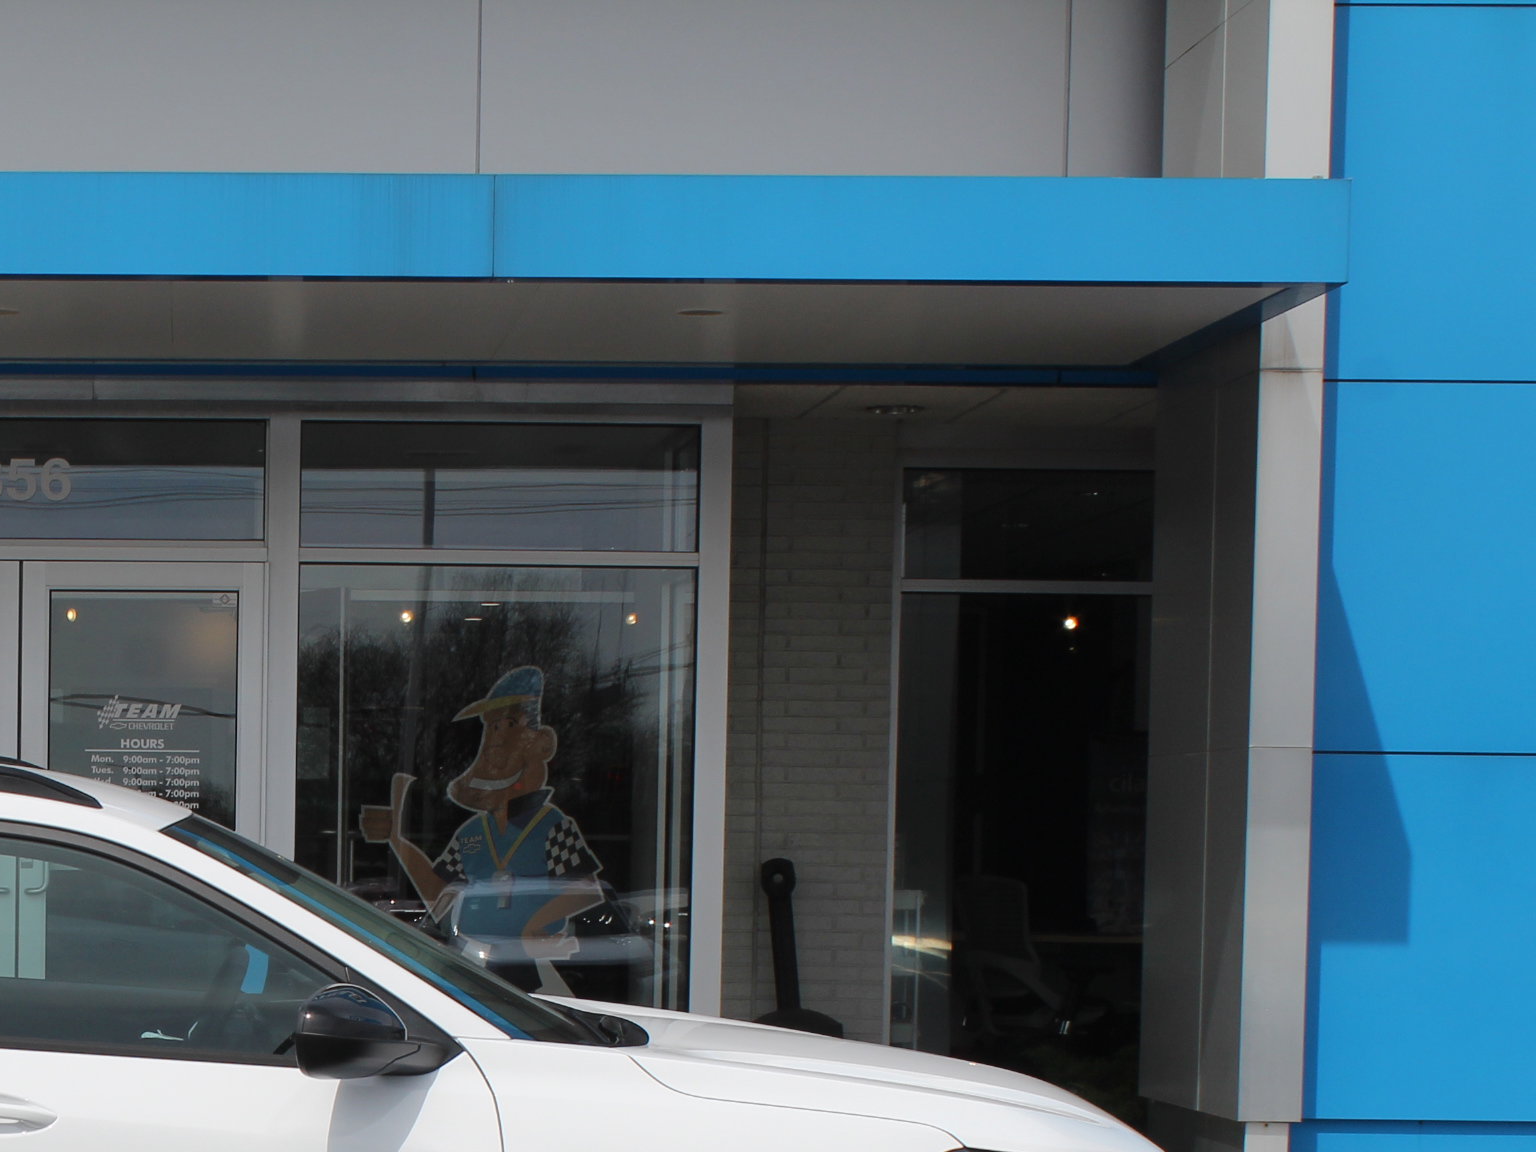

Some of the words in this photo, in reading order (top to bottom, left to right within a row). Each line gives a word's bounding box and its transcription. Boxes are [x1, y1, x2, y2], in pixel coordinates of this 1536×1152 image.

[114, 703, 182, 719] TEAM
[128, 722, 175, 731] CHEVROLET
[120, 738, 165, 750] HOURS
[91, 754, 114, 763] Mon.
[122, 755, 157, 764] 9:00am
[166, 755, 200, 766] 7:00pm
[91, 766, 114, 774] Tues.
[122, 766, 157, 775] 9:00am
[166, 767, 200, 777] 7:00pm
[122, 778, 157, 787] 9:00am
[165, 778, 200, 788] 7:00pm
[165, 789, 200, 799] 7:00pm
